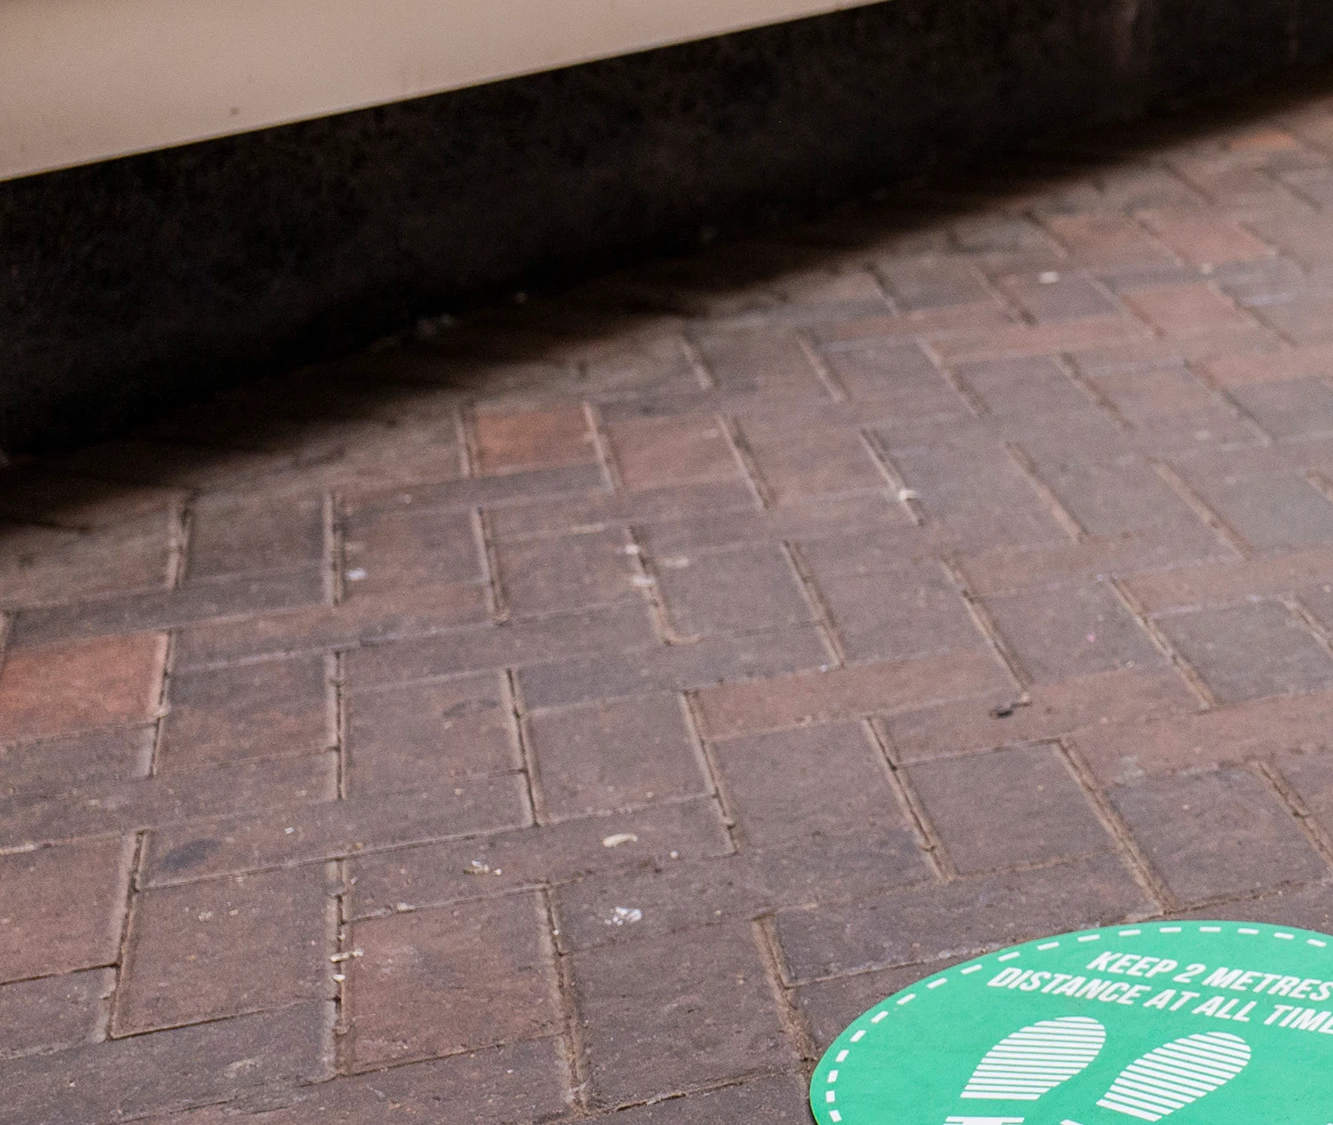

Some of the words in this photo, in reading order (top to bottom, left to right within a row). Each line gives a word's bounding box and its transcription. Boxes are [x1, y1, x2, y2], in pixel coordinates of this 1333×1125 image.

[1086, 951, 1178, 979] KEEP
[1173, 964, 1206, 984] 2
[987, 967, 1152, 1006] DISTANCE
[1143, 989, 1200, 1012] AT
[1192, 996, 1257, 1023] ALL
